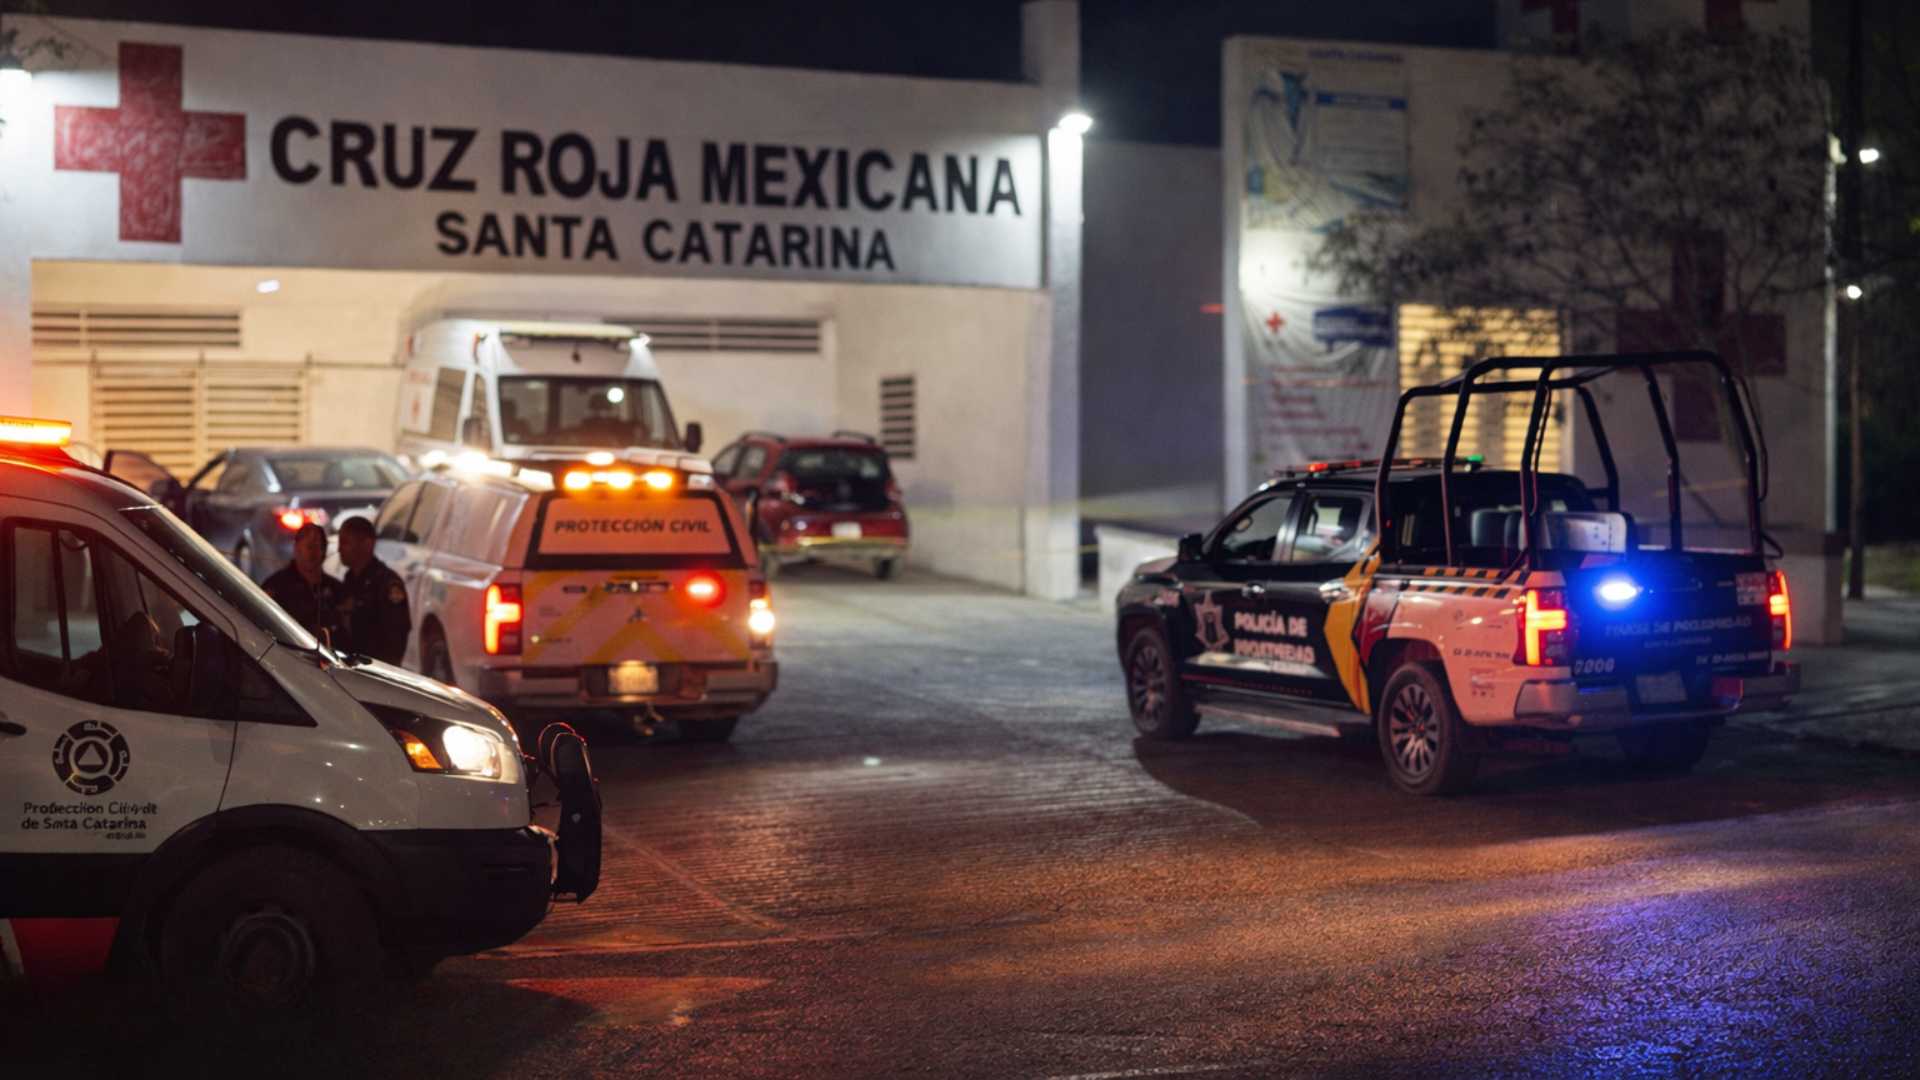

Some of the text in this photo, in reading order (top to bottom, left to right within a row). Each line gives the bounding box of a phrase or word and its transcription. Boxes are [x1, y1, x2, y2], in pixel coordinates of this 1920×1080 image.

[269, 114, 1022, 216] CRUZ ROJA MEXICANA
[436, 211, 895, 271] SANTA CATARINA
[670, 519, 711, 533] CIVIL
[1288, 616, 1308, 637] DE
[21, 817, 39, 829] de
